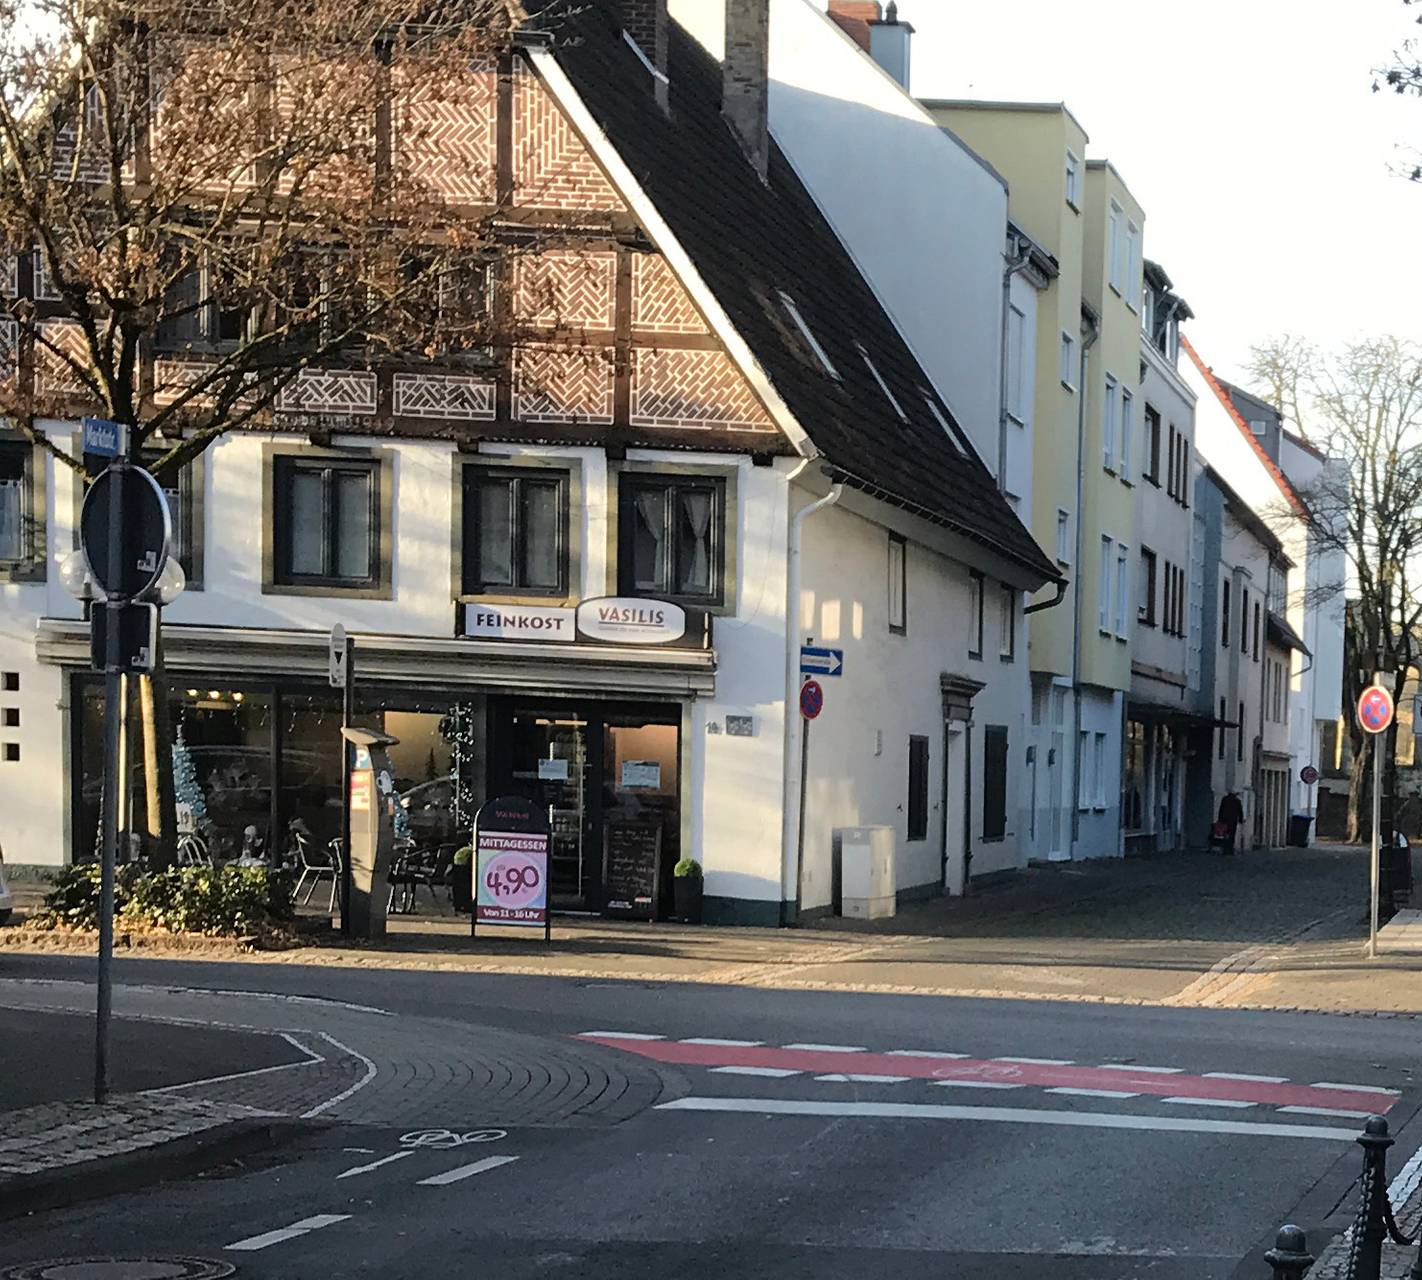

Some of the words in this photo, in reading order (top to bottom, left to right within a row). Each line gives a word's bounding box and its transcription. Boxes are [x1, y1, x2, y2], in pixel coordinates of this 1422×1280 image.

[476, 613, 564, 630] FEINKOST
[599, 607, 665, 624] VASILIS
[480, 838, 547, 850] MITTAGESSEN
[487, 865, 540, 896] 4,90
[483, 908, 499, 917] Von
